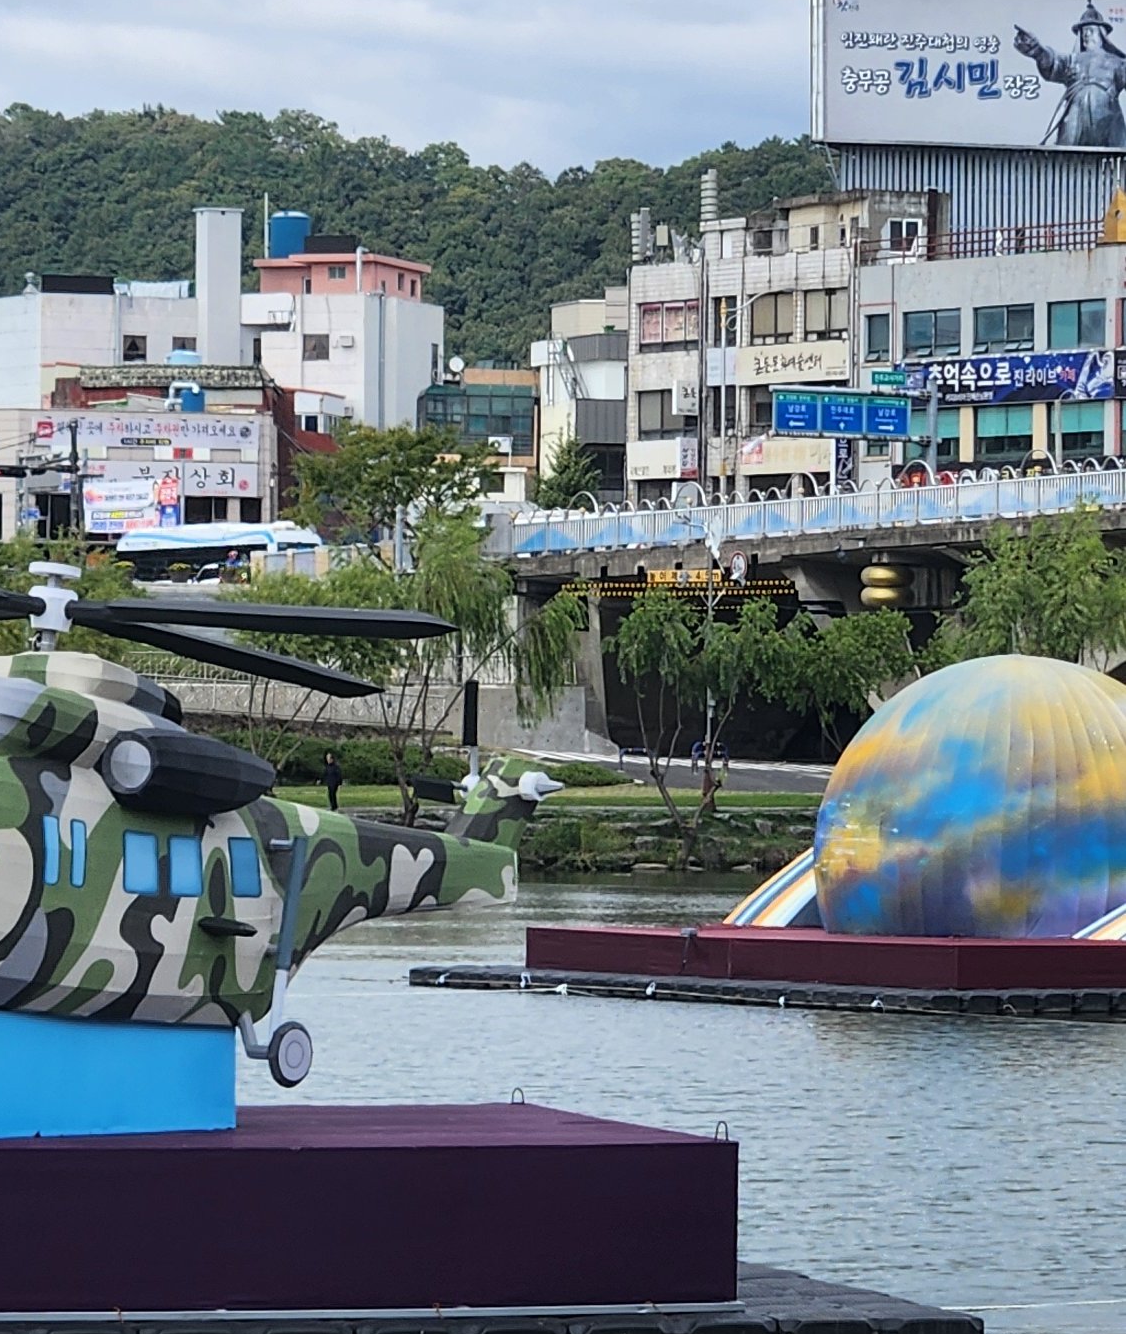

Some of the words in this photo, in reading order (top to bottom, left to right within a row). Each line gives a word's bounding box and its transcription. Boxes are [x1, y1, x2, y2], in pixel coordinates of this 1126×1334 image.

[840, 32, 898, 49] 임진왜란
[900, 35, 970, 52] 진주대첩의
[973, 38, 1000, 53] 영웅
[841, 67, 891, 95] 충무공
[894, 57, 1001, 99] 김시민
[1002, 75, 1041, 99] 장군
